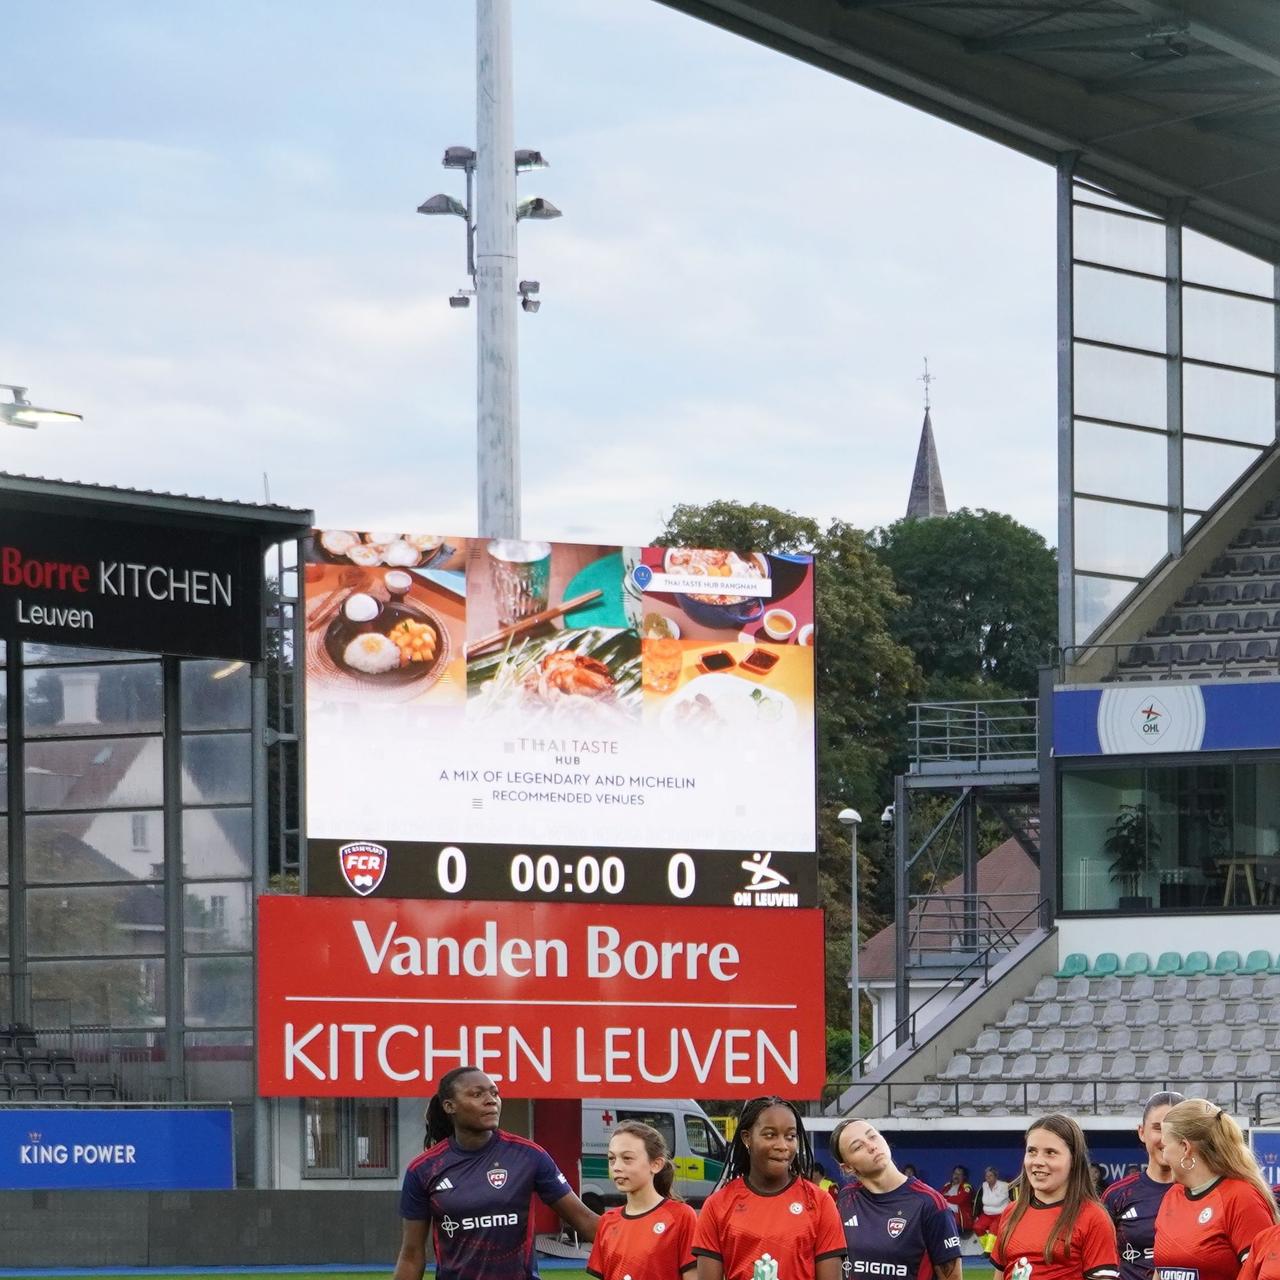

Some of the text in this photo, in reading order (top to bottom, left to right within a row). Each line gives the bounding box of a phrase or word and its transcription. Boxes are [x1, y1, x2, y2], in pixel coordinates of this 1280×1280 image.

[1, 546, 233, 608] Borre KITCHEN
[18, 598, 95, 630] Leuven
[1142, 723, 1160, 734] OHL
[572, 739, 619, 755] TASTE
[555, 756, 581, 766] HUB
[439, 769, 696, 790] A MIX OF LEGENDARY AND MICHELIN
[492, 789, 645, 806] RECOMMENDED VENUES
[346, 855, 381, 870] FCR
[436, 846, 467, 894] 0
[510, 852, 626, 896] 00:00
[667, 852, 697, 899] 0
[733, 892, 799, 908] OH LEUVEN
[351, 920, 741, 982] Vanden Borre
[284, 1022, 800, 1086] KITCHEN LEUVEN
[21, 1144, 137, 1165] KING POWER
[490, 1173, 506, 1182] FCR
